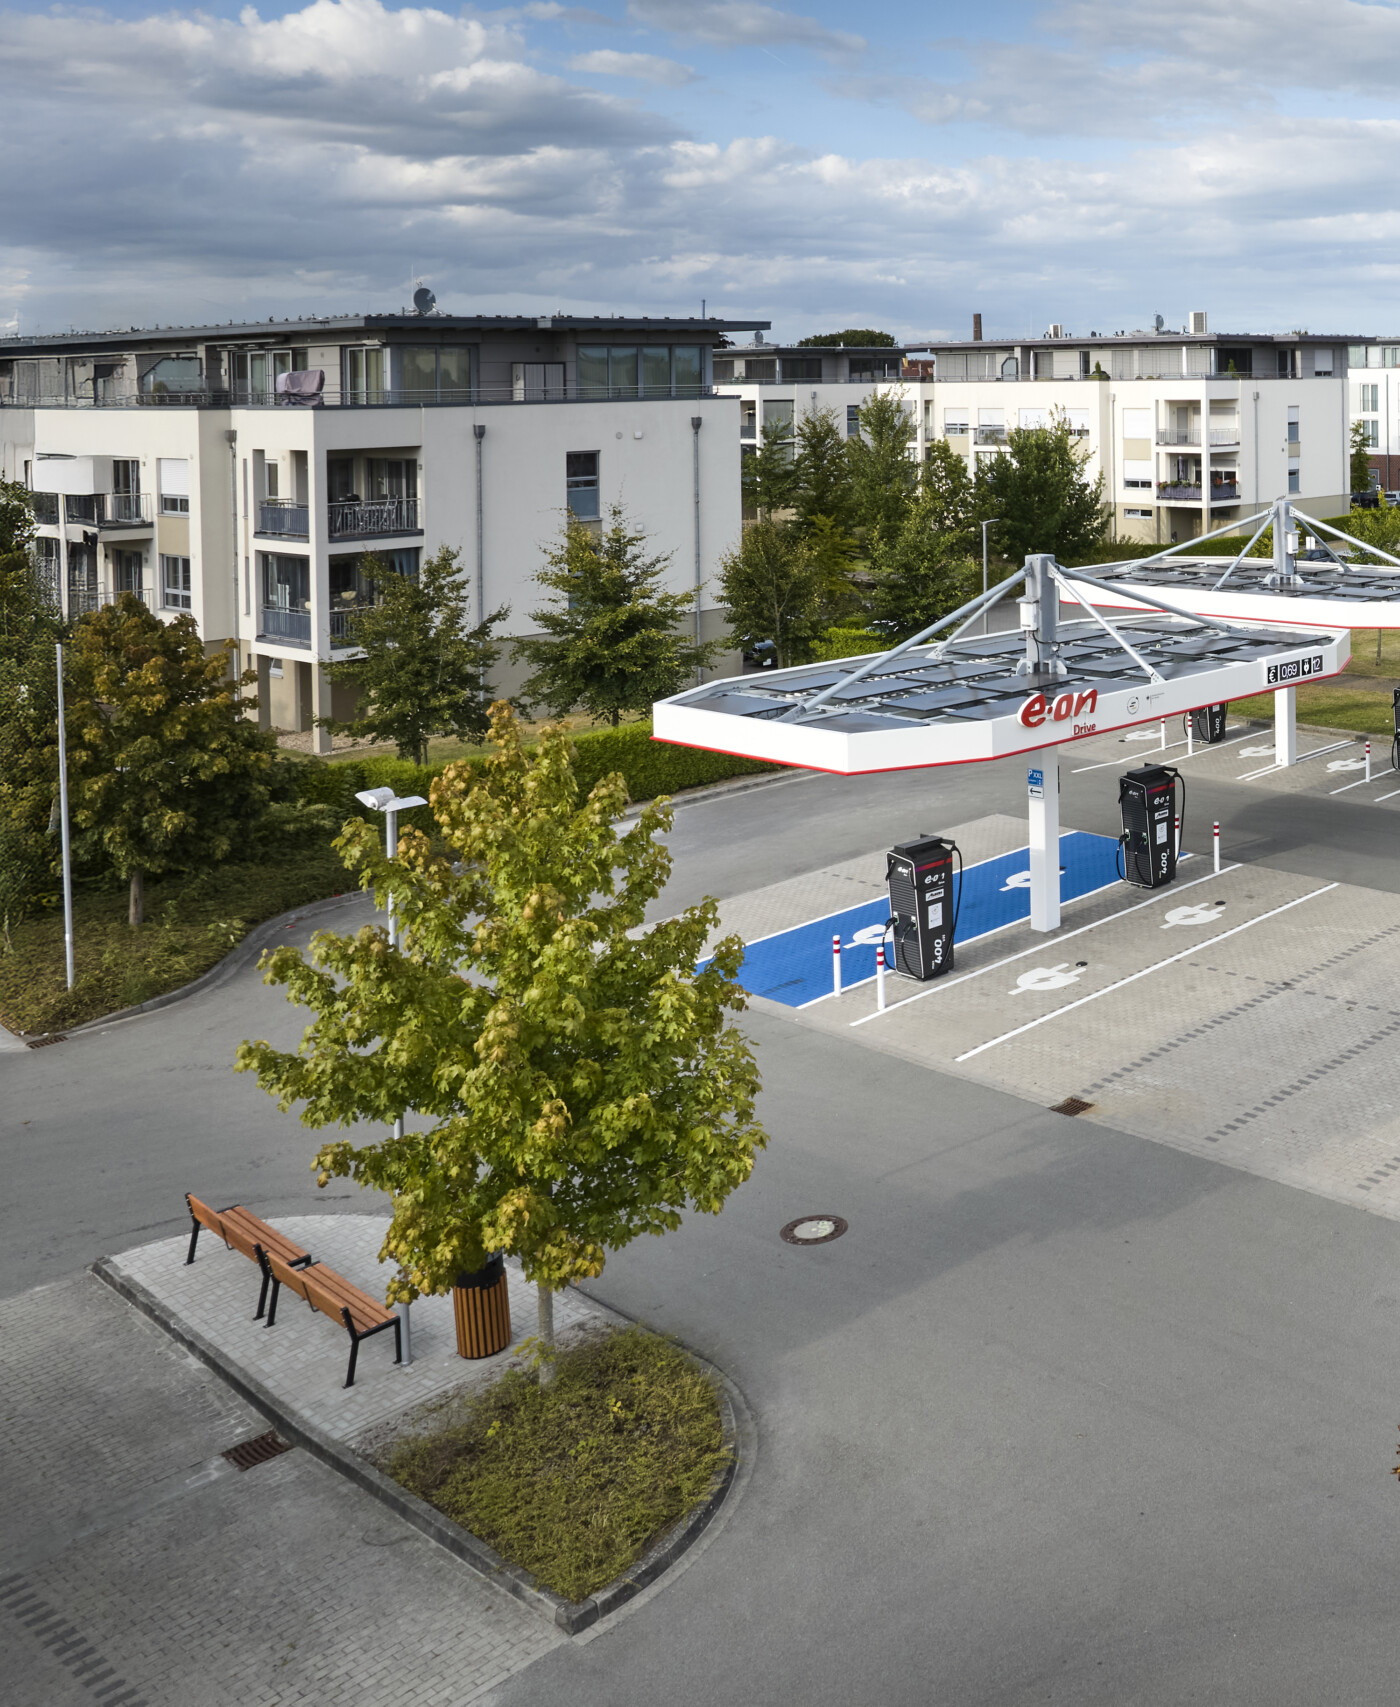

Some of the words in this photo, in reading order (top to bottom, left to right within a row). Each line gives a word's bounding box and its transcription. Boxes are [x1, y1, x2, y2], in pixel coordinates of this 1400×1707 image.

[1282, 664, 1298, 679] 0,69
[1073, 722, 1097, 736] Drive
[1160, 852, 1168, 874] 400
[934, 939, 943, 964] 400
